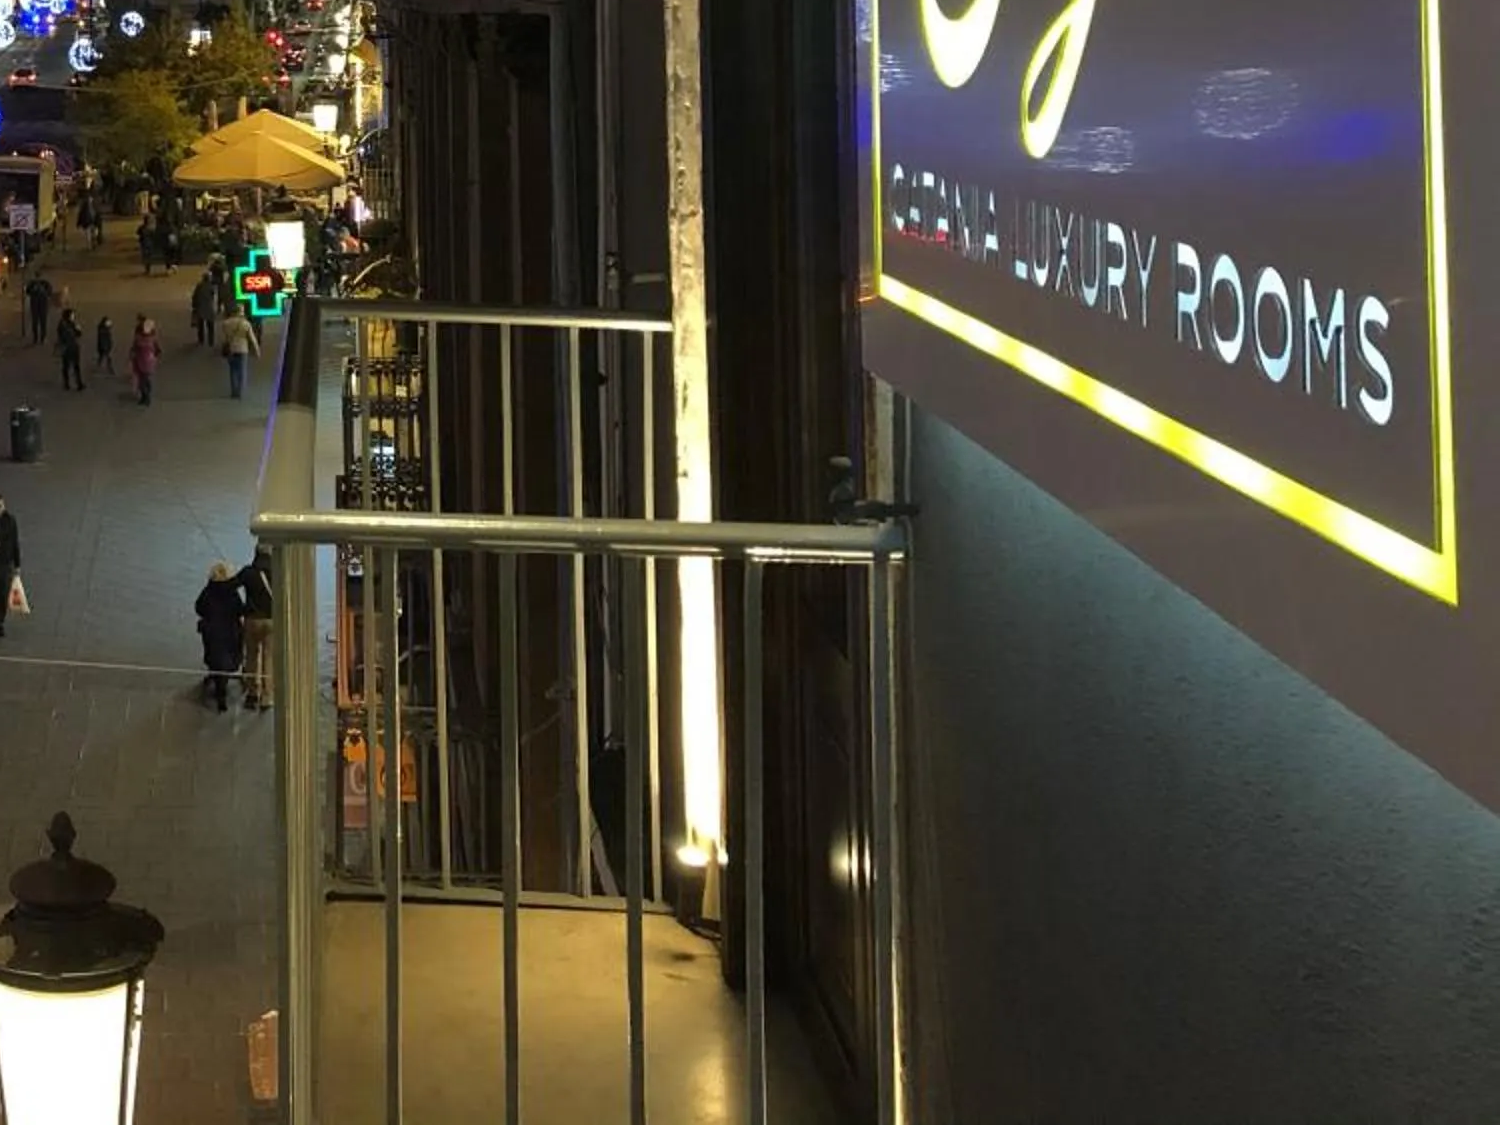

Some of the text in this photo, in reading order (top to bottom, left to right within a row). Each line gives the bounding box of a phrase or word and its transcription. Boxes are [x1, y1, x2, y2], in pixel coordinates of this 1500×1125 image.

[891, 163, 1394, 426] CATANIA LUXURY ROOMS
